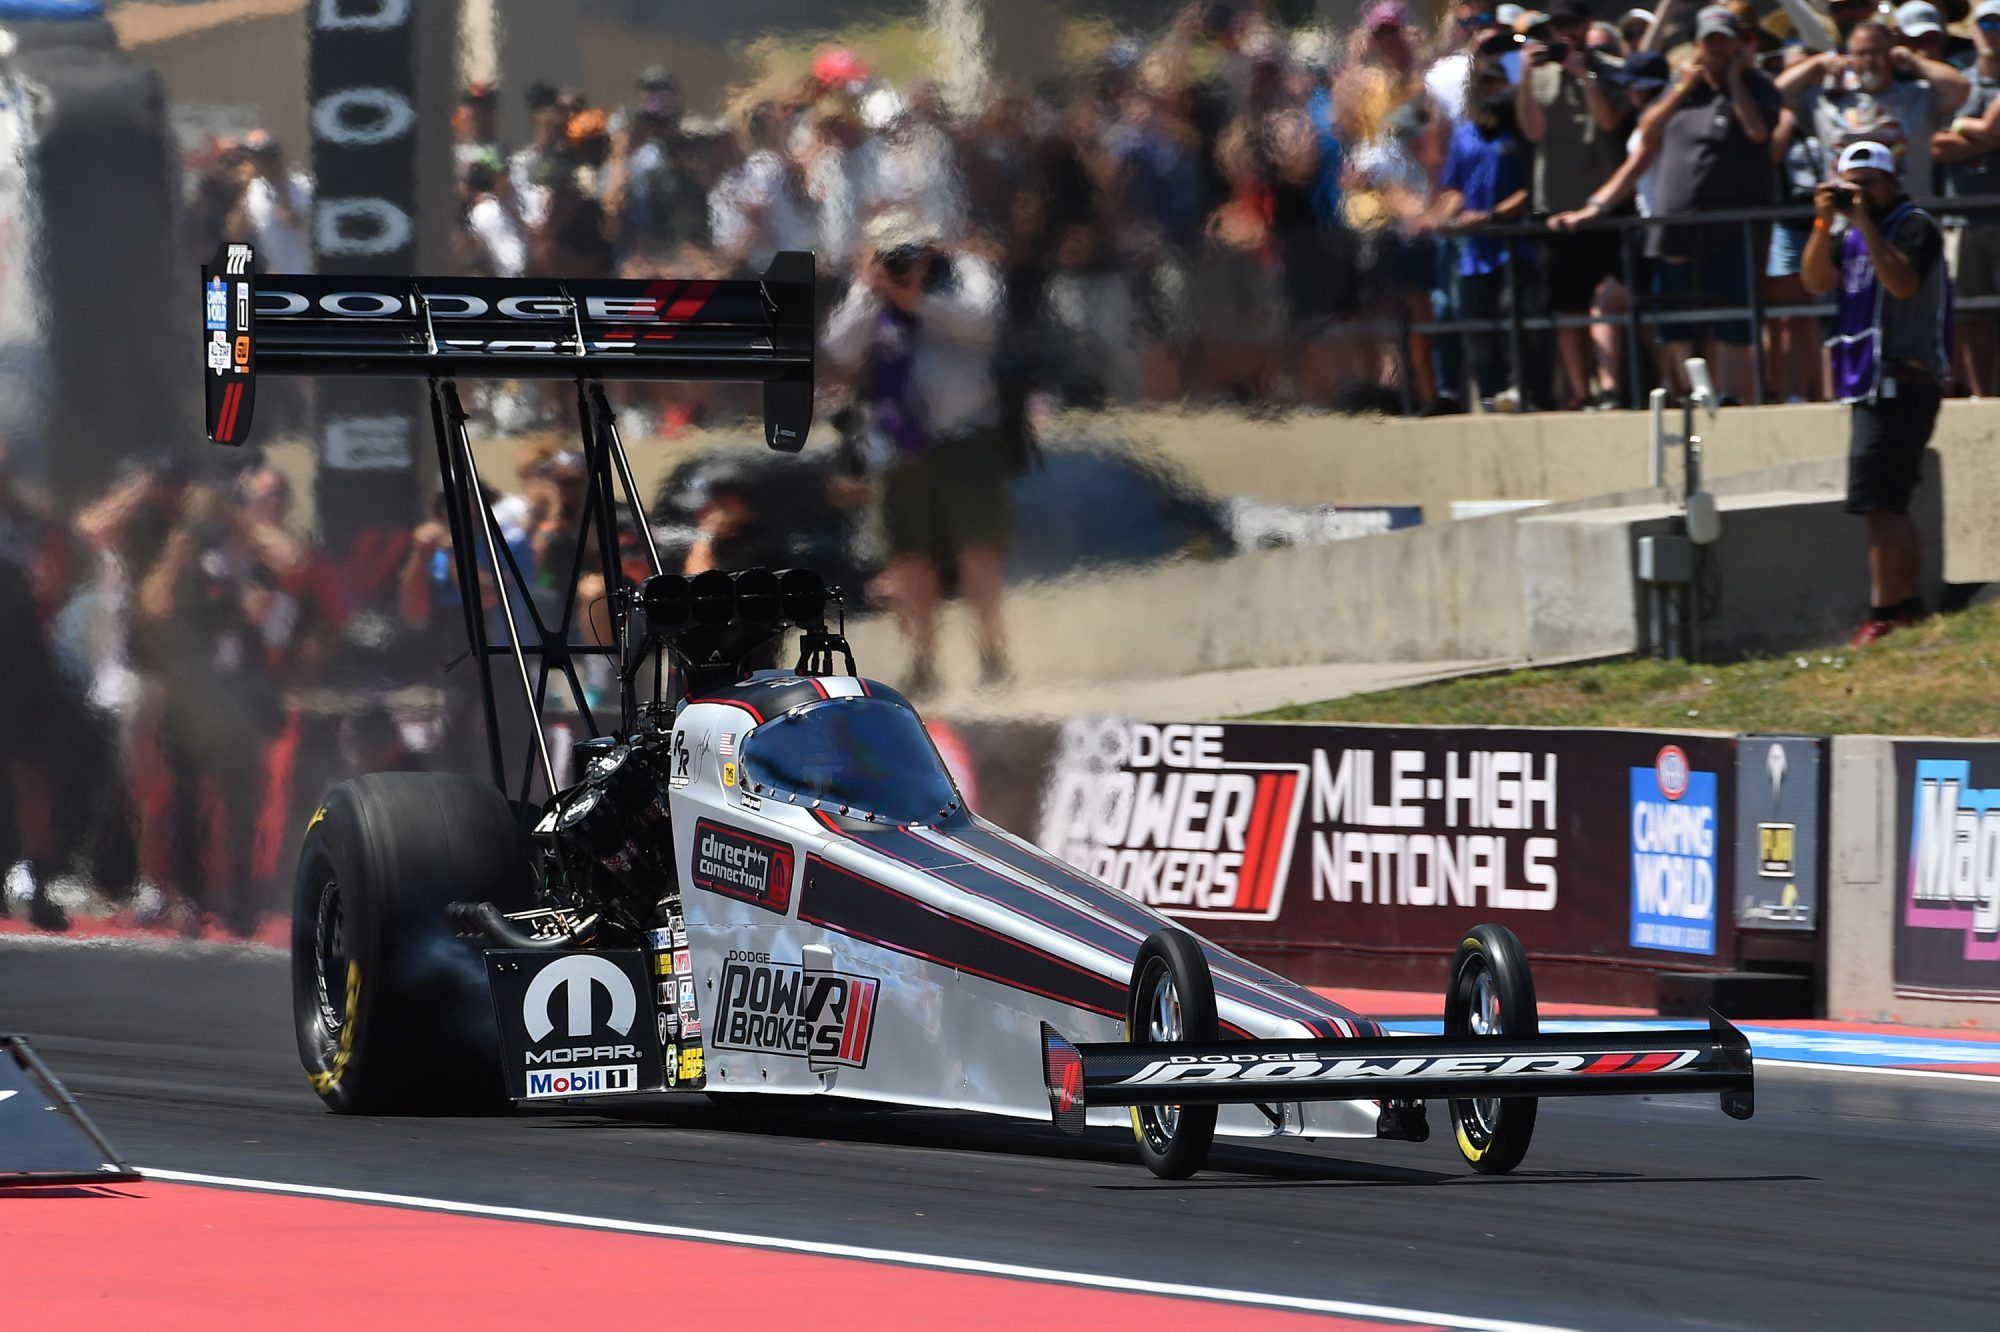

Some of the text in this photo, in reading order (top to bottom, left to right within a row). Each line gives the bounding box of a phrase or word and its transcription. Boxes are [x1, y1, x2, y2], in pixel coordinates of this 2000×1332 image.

[255, 292, 658, 320] DODGE
[1312, 748, 1557, 830] MILE-HIGH
[1633, 800, 1714, 858] CAMPING
[701, 833, 758, 869] direct
[699, 857, 768, 892] connection
[1312, 830, 1558, 912] NATIONALS
[729, 950, 770, 964] DODGE
[525, 1044, 636, 1065] MOPAR
[1141, 1054, 1587, 1083] POWER
[1169, 1054, 1318, 1064] DODGE
[530, 1070, 621, 1094] Mobil 1
